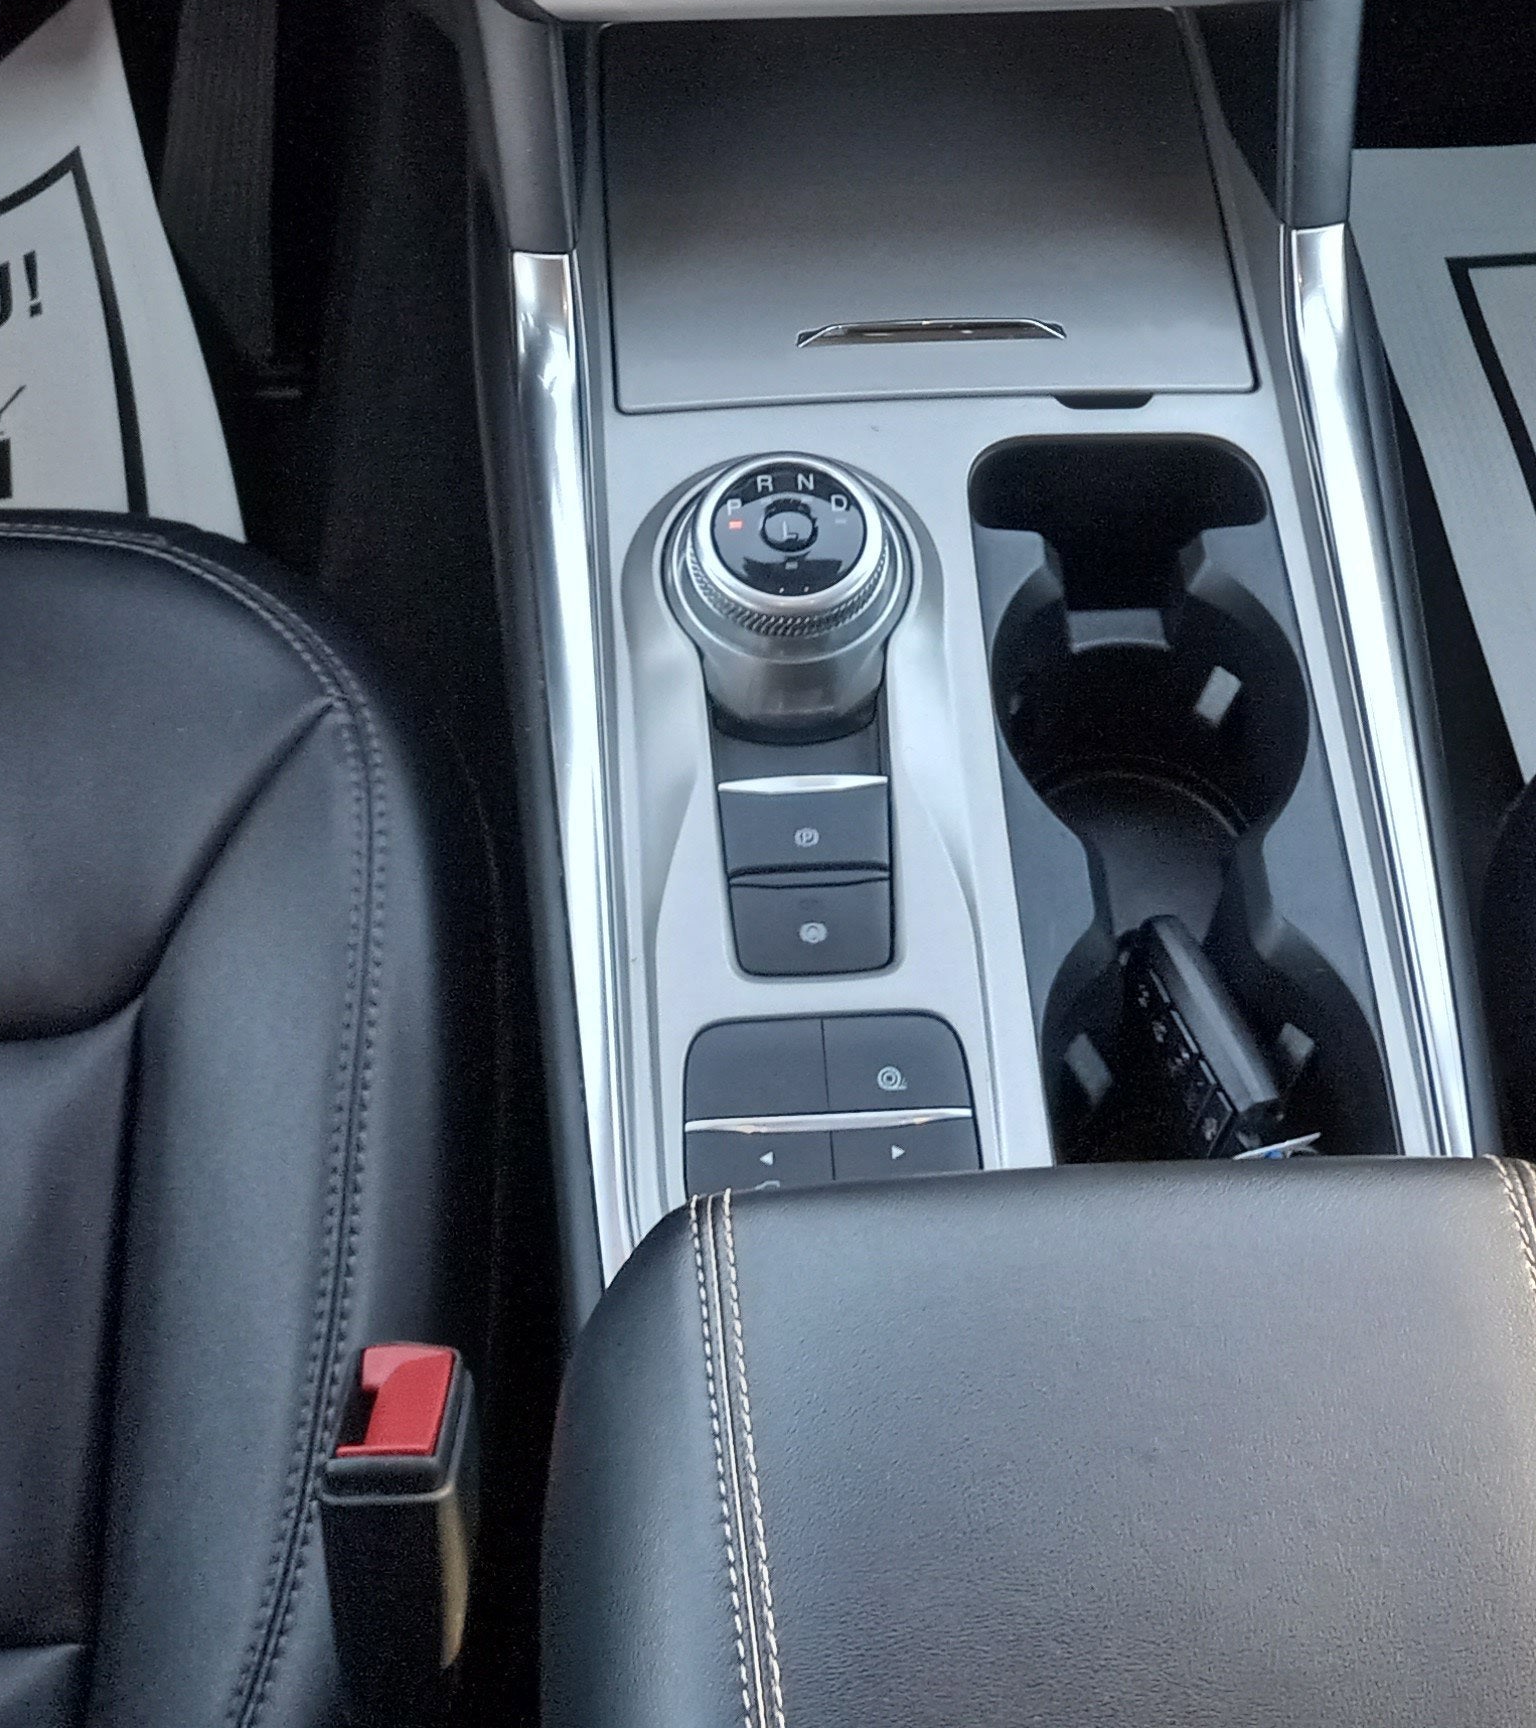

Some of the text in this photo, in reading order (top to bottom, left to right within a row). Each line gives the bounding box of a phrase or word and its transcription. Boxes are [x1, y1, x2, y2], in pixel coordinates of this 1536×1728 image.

[756, 475, 773, 492] R
[797, 474, 814, 491] N
[727, 498, 742, 515] P
[831, 495, 848, 512] D
[782, 521, 798, 540] L
